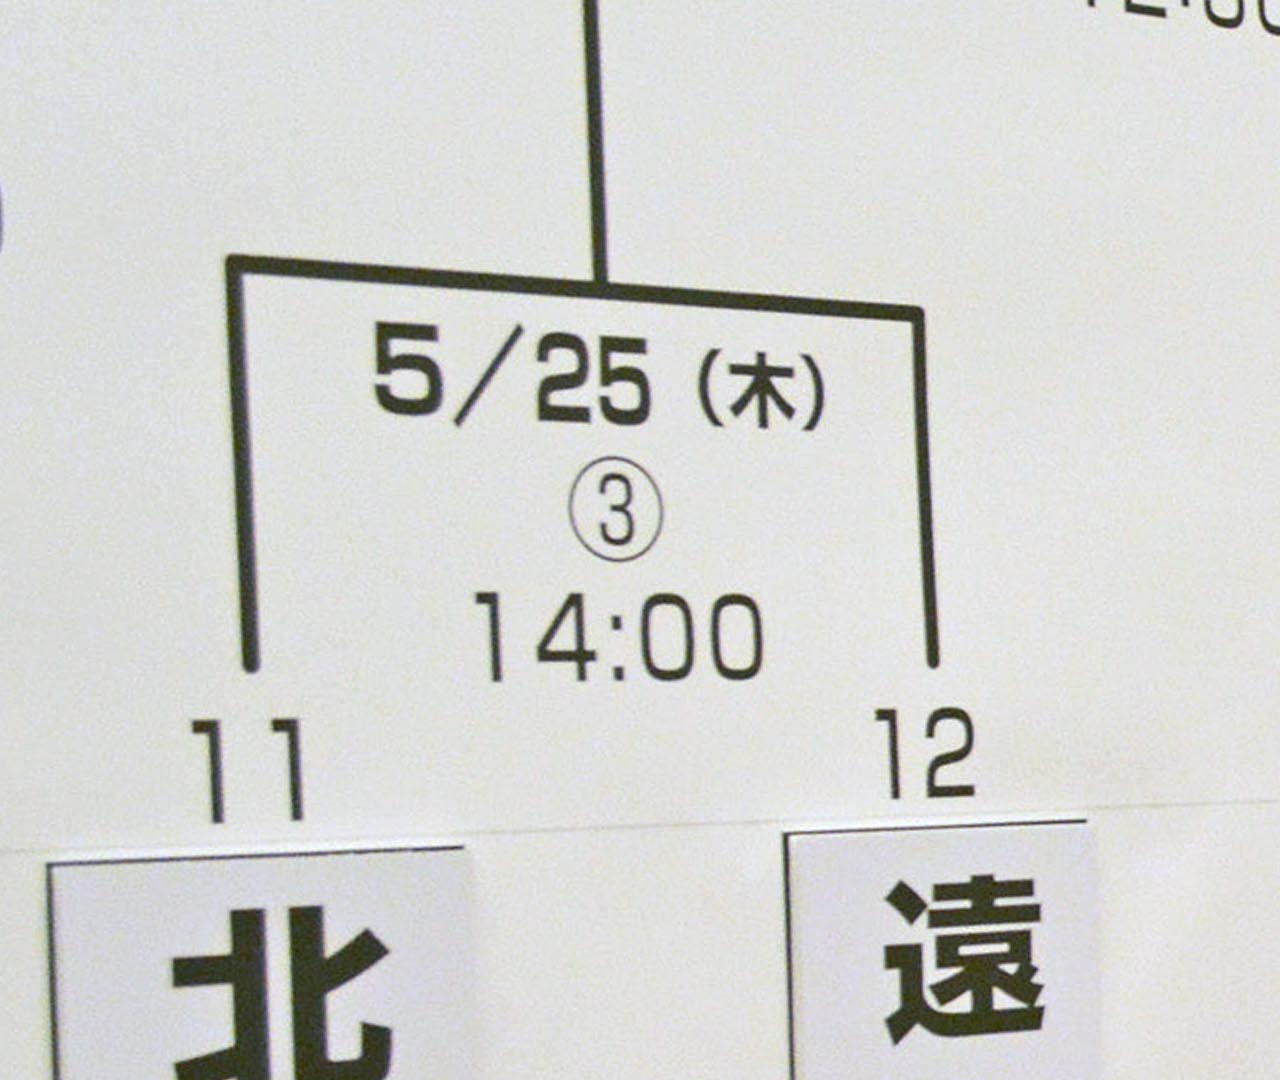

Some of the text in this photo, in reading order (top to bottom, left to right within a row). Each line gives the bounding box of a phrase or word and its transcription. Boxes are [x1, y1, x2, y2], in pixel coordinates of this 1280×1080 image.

[474, 591, 764, 683] 14:00
[191, 717, 304, 825] 11
[874, 706, 976, 800] 12
